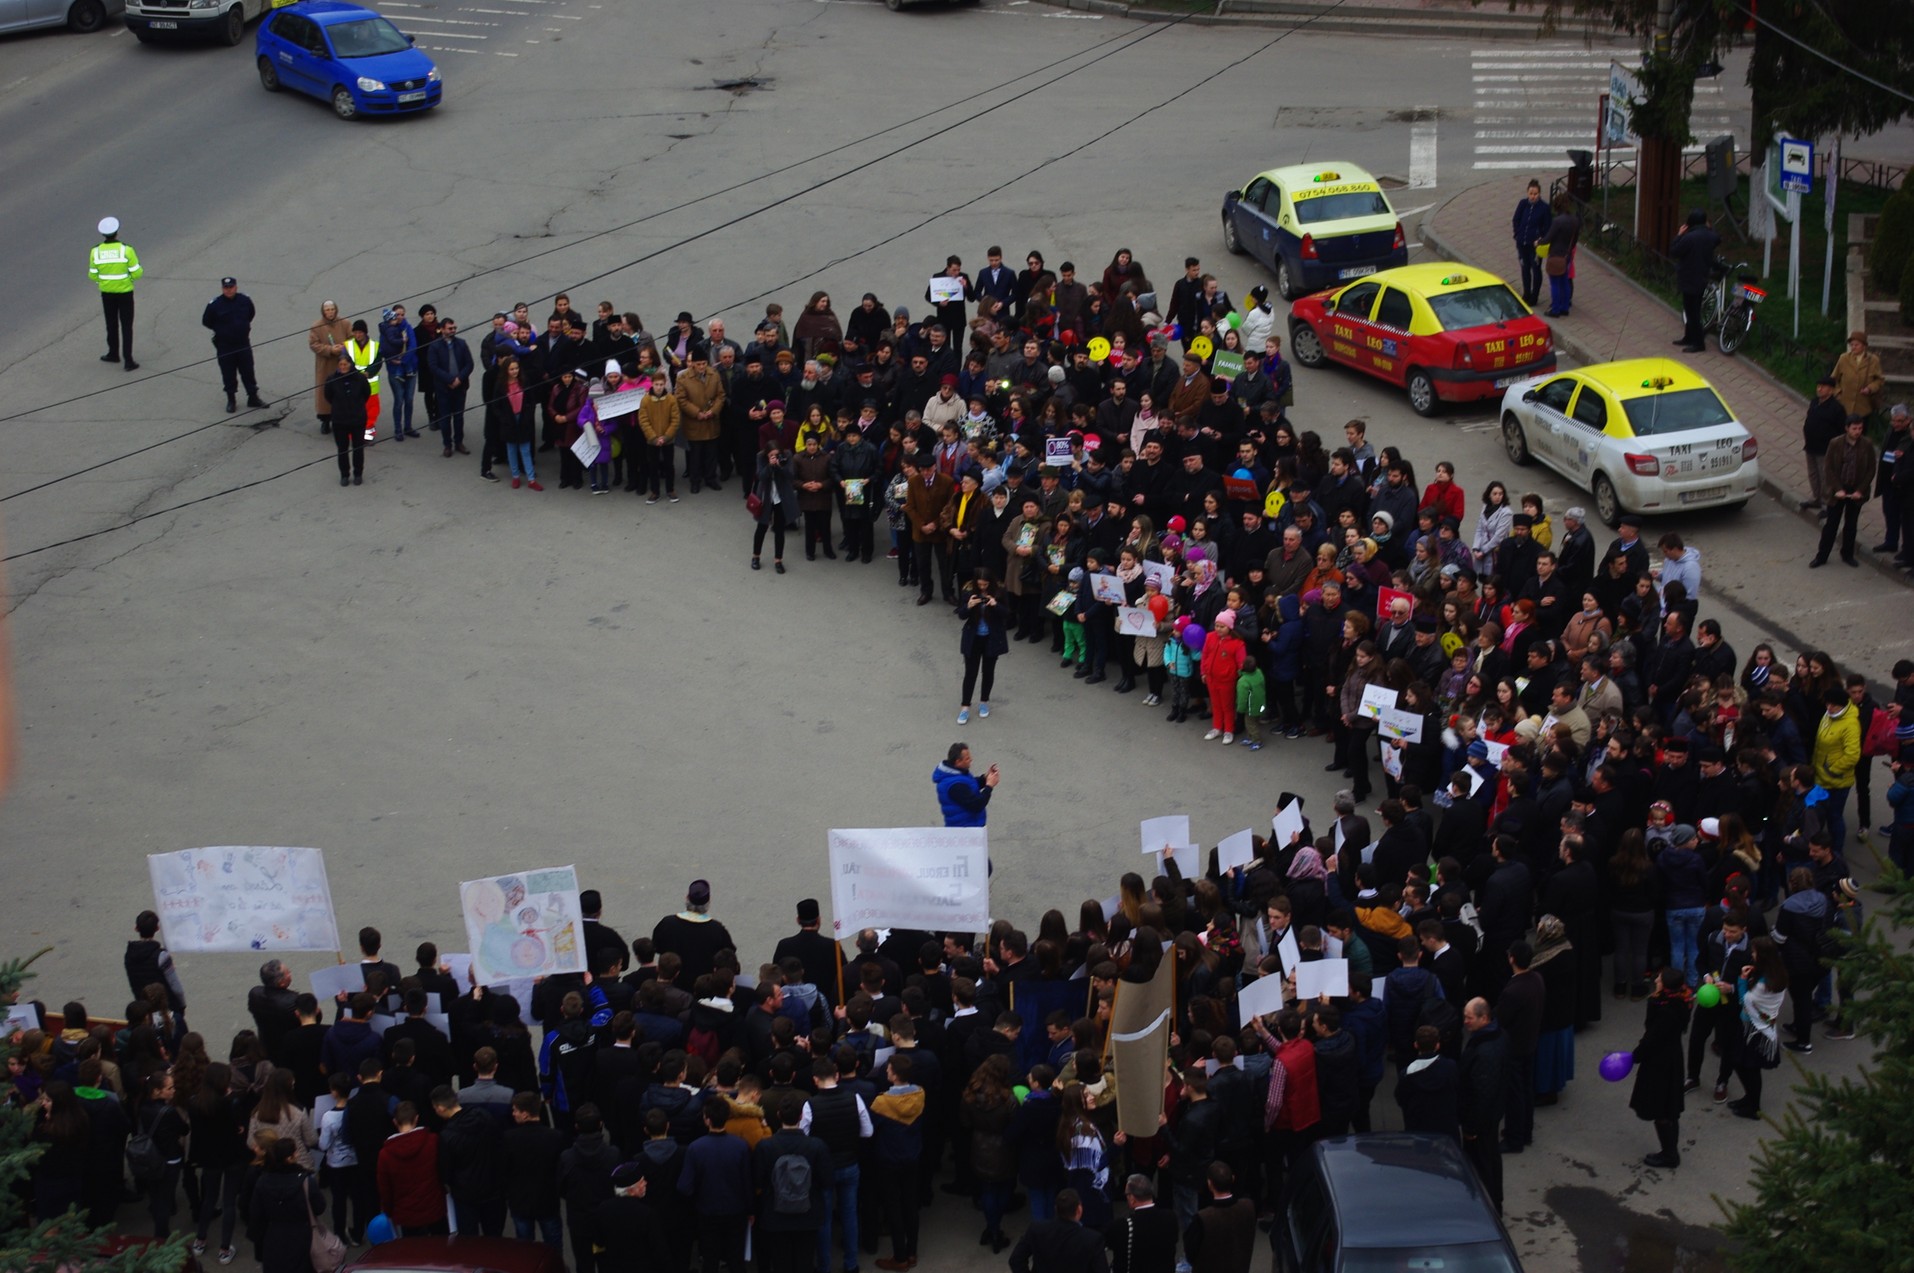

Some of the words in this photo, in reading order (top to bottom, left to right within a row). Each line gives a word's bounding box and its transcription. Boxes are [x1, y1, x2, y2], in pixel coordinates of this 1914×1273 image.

[1334, 324, 1353, 341] TAXI
[1367, 336, 1383, 351] LEO
[1485, 340, 1505, 354] TAXI
[1520, 334, 1534, 348] LEO
[1669, 444, 1692, 456] TAXI
[1716, 438, 1733, 450] LEO
